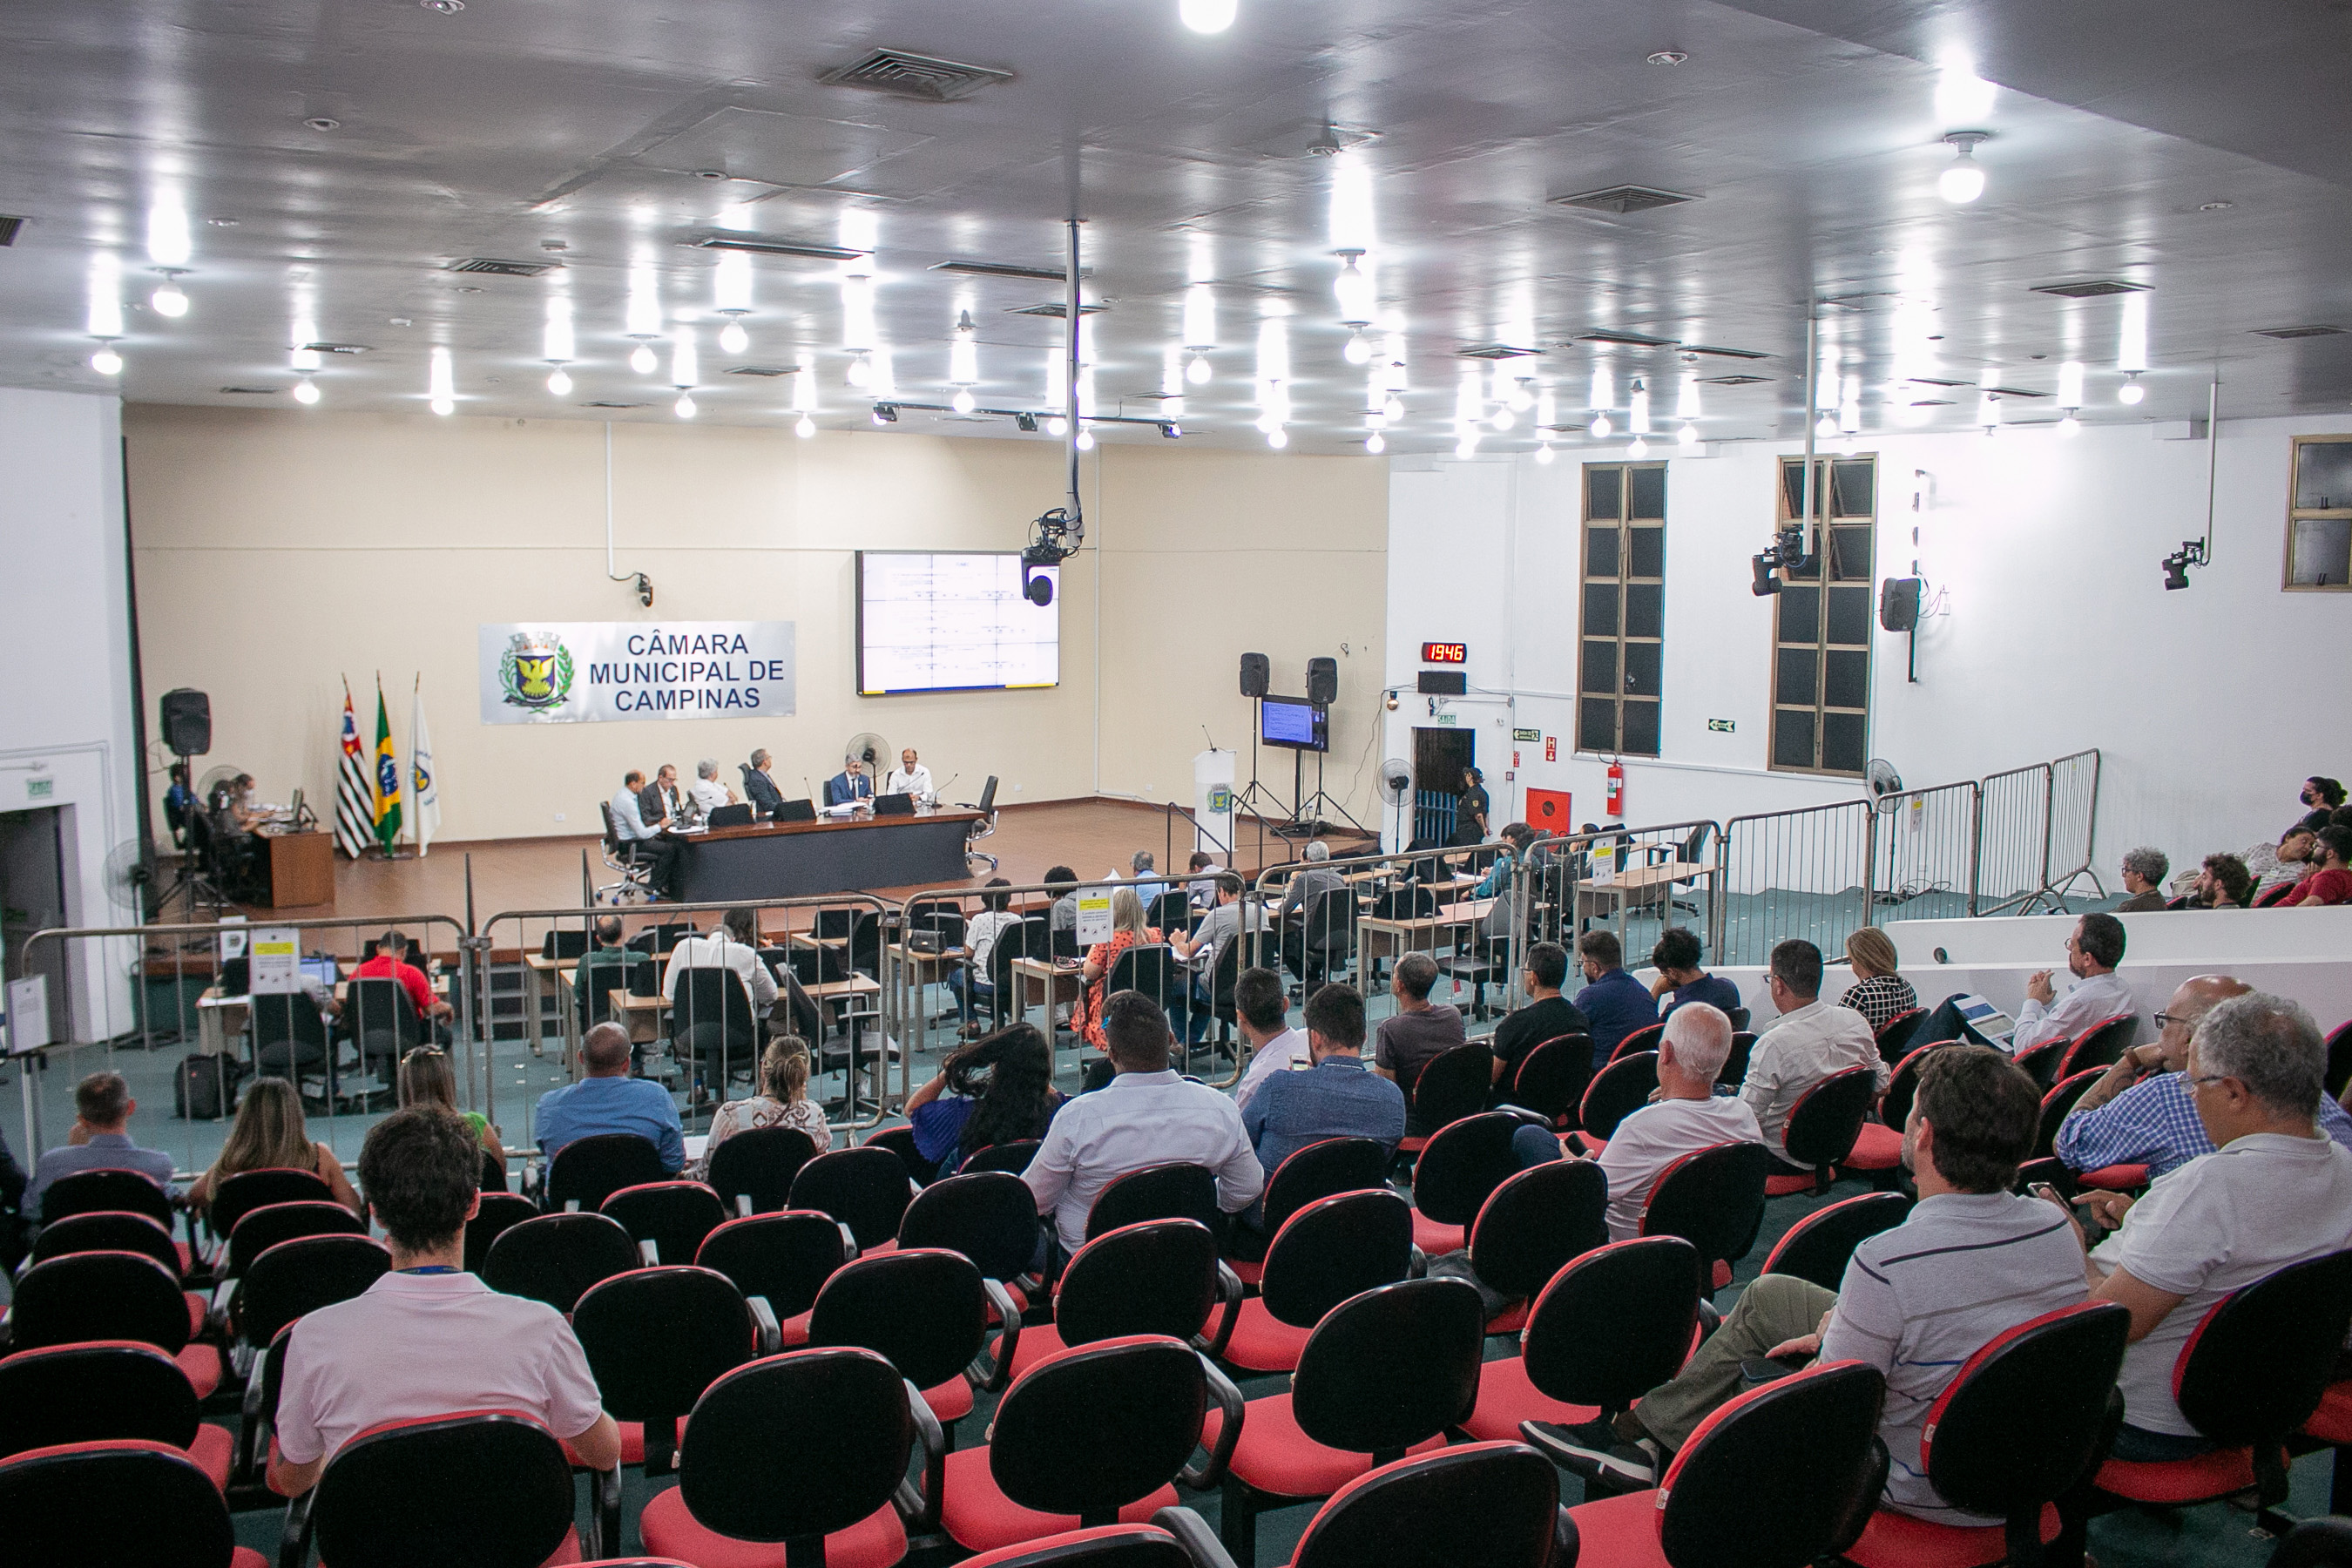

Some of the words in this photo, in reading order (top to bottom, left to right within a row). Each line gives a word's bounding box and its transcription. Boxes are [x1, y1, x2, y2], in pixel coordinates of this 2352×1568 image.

[628, 629, 748, 656] CÂMARA
[1431, 644, 1463, 661] 1946
[590, 661, 740, 684] MUNICIPAL
[749, 660, 784, 681] DE
[615, 687, 760, 712] CAMPINAS
[1547, 737, 1555, 749] H
